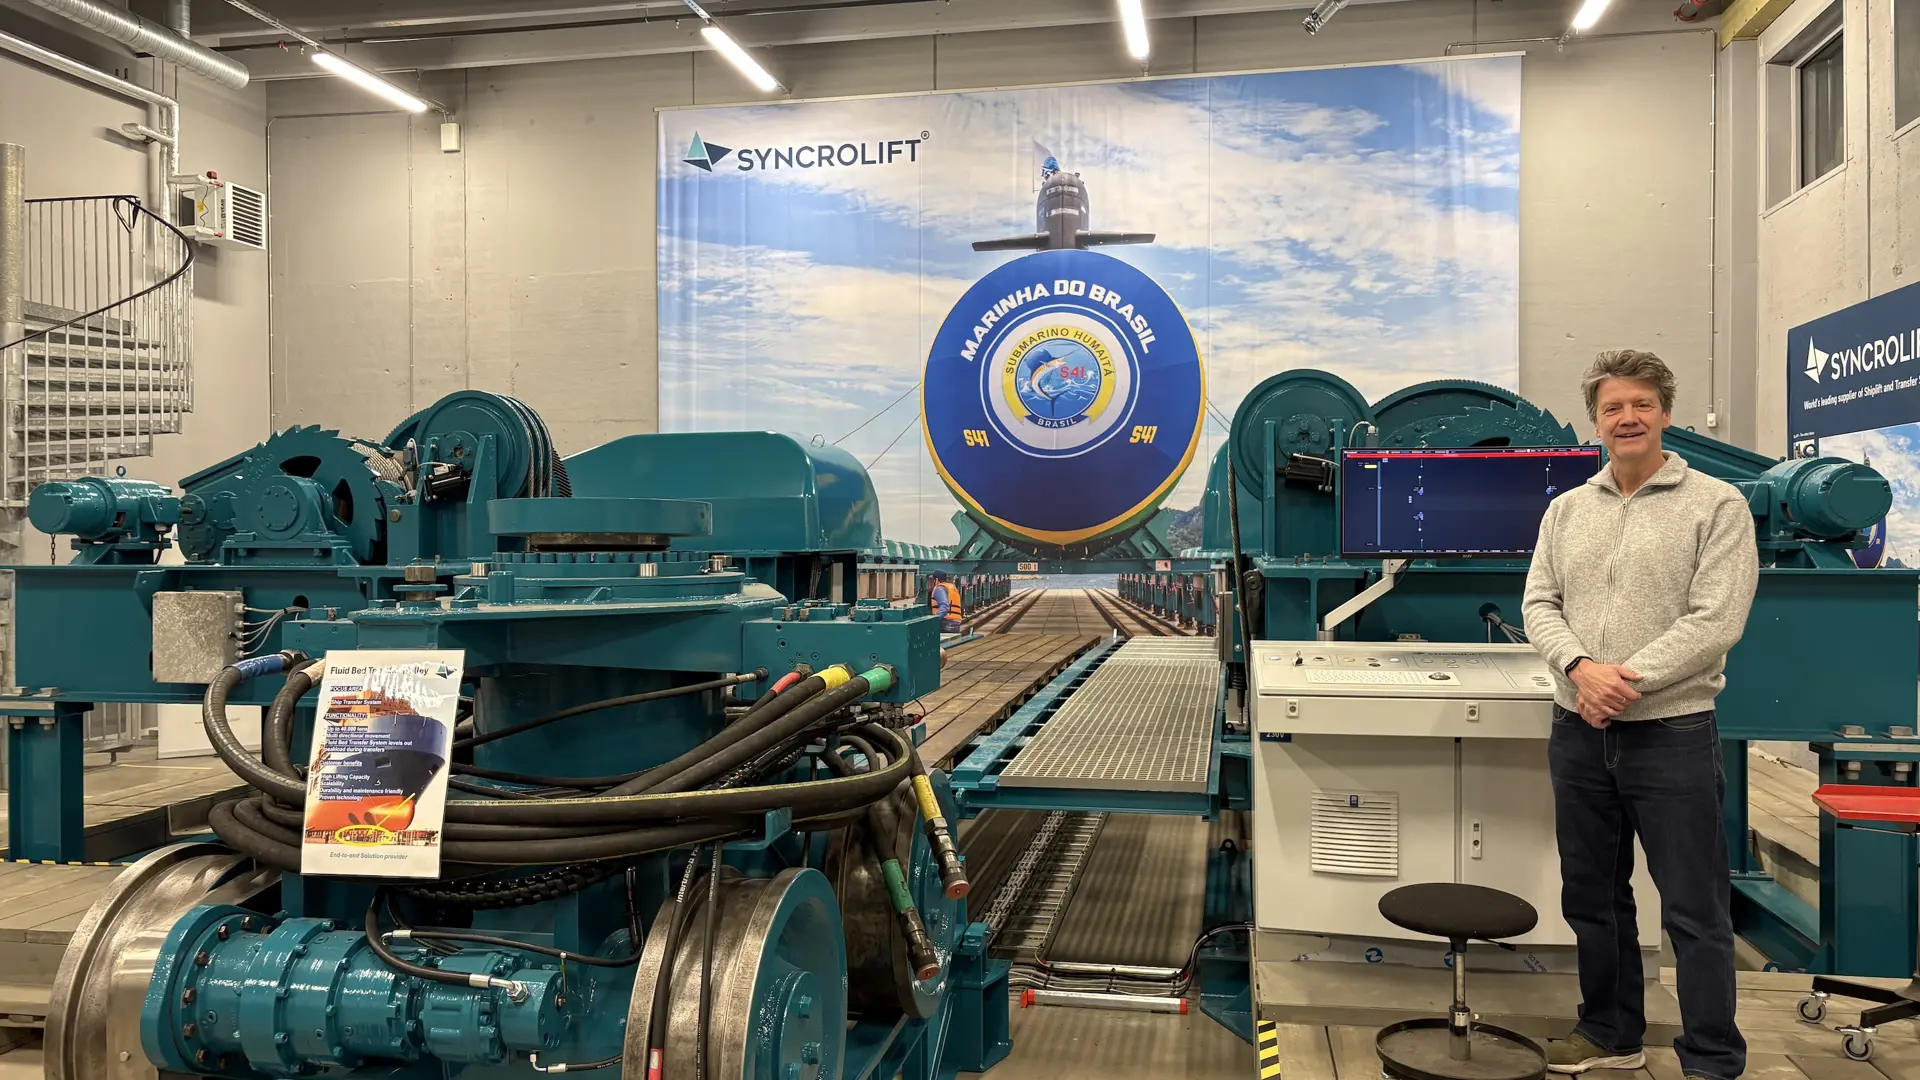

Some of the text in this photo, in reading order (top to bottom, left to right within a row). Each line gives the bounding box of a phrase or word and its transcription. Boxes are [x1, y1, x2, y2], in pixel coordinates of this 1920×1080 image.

[960, 279, 1156, 361] MARINHA DO BRASIL
[1005, 328, 1115, 377] SUBMARINO HUMAITÁ
[1060, 366, 1085, 379] S41
[1804, 376, 1918, 410] World's leading supplier of Shiplift and Transfer
[1037, 418, 1077, 428] BRASIL
[963, 429, 990, 447] S41
[1129, 425, 1158, 444] S41
[1019, 562, 1032, 571] 500
[331, 666, 351, 675] Fluid
[351, 666, 367, 675] Bed
[329, 851, 360, 859] End-to-end
[384, 852, 408, 861] provider
